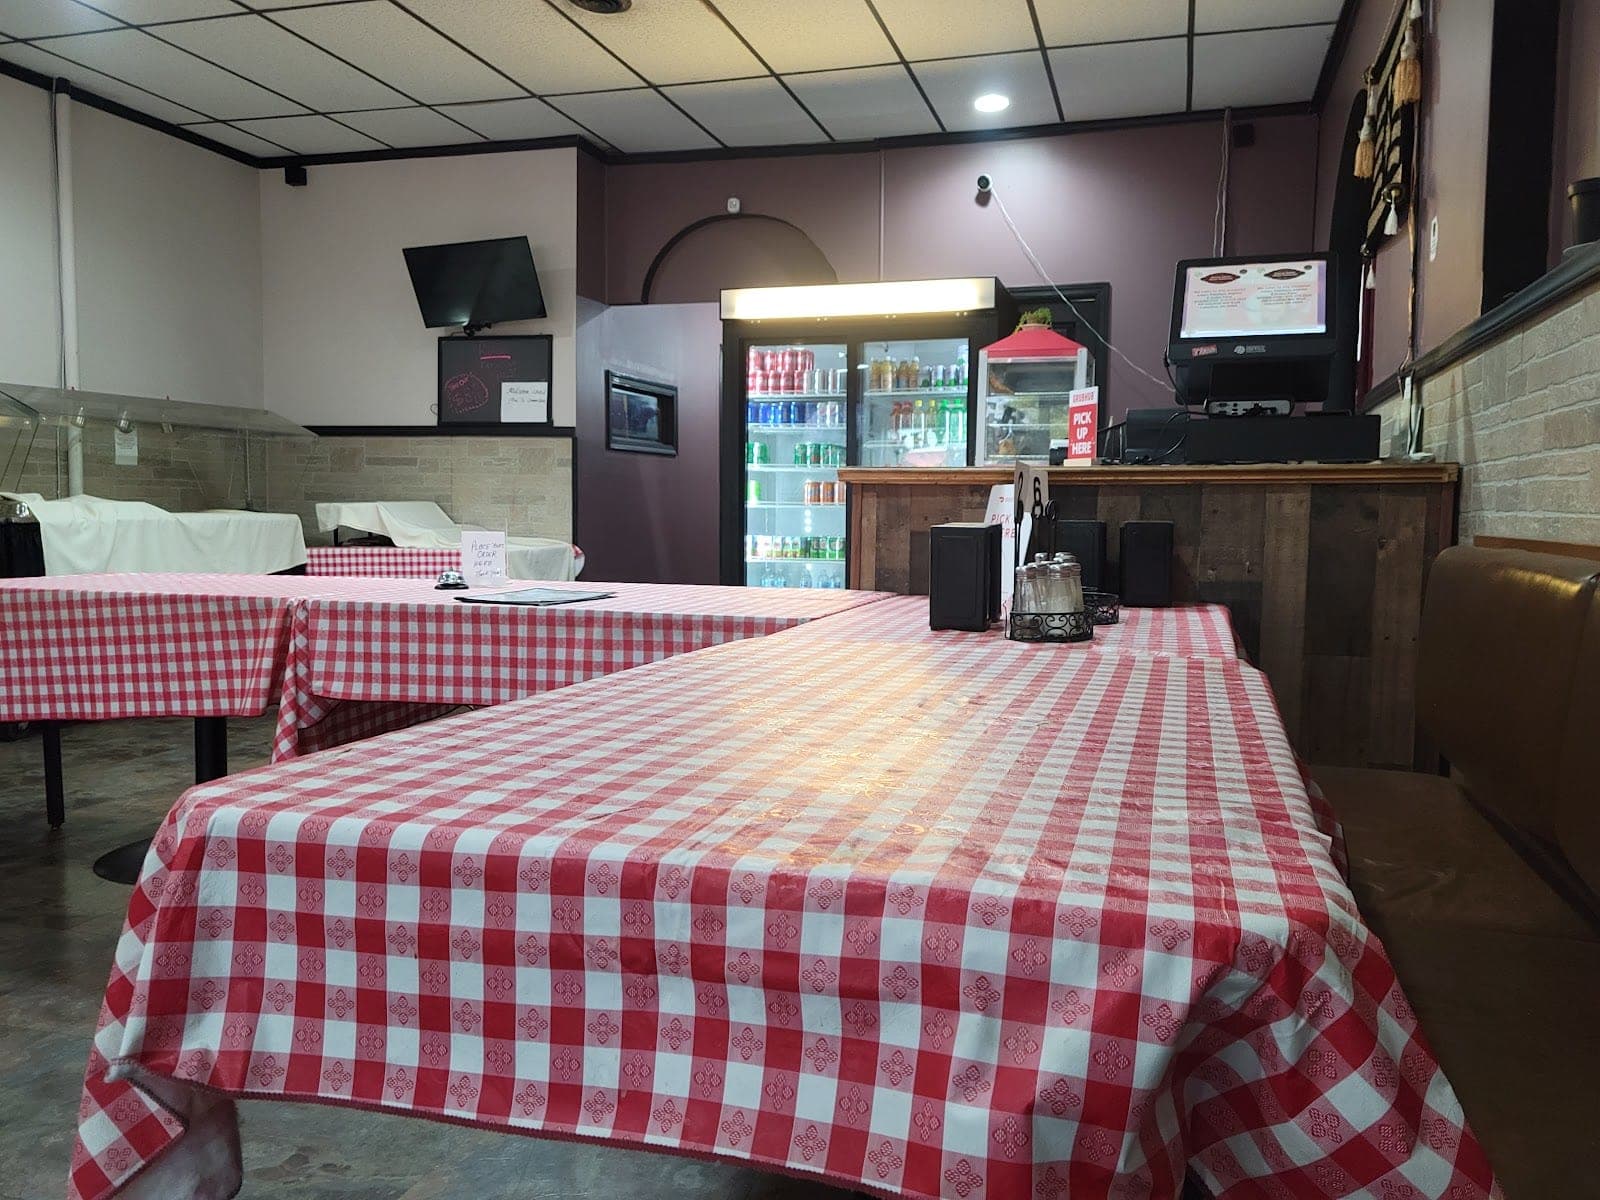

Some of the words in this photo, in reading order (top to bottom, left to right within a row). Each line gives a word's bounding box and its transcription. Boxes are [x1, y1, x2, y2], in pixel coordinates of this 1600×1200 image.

[1073, 412, 1092, 425] PICK
[1076, 427, 1088, 440] UP
[1072, 442, 1092, 455] HERE
[1033, 476, 1042, 506] 6
[991, 514, 1010, 524] PICK
